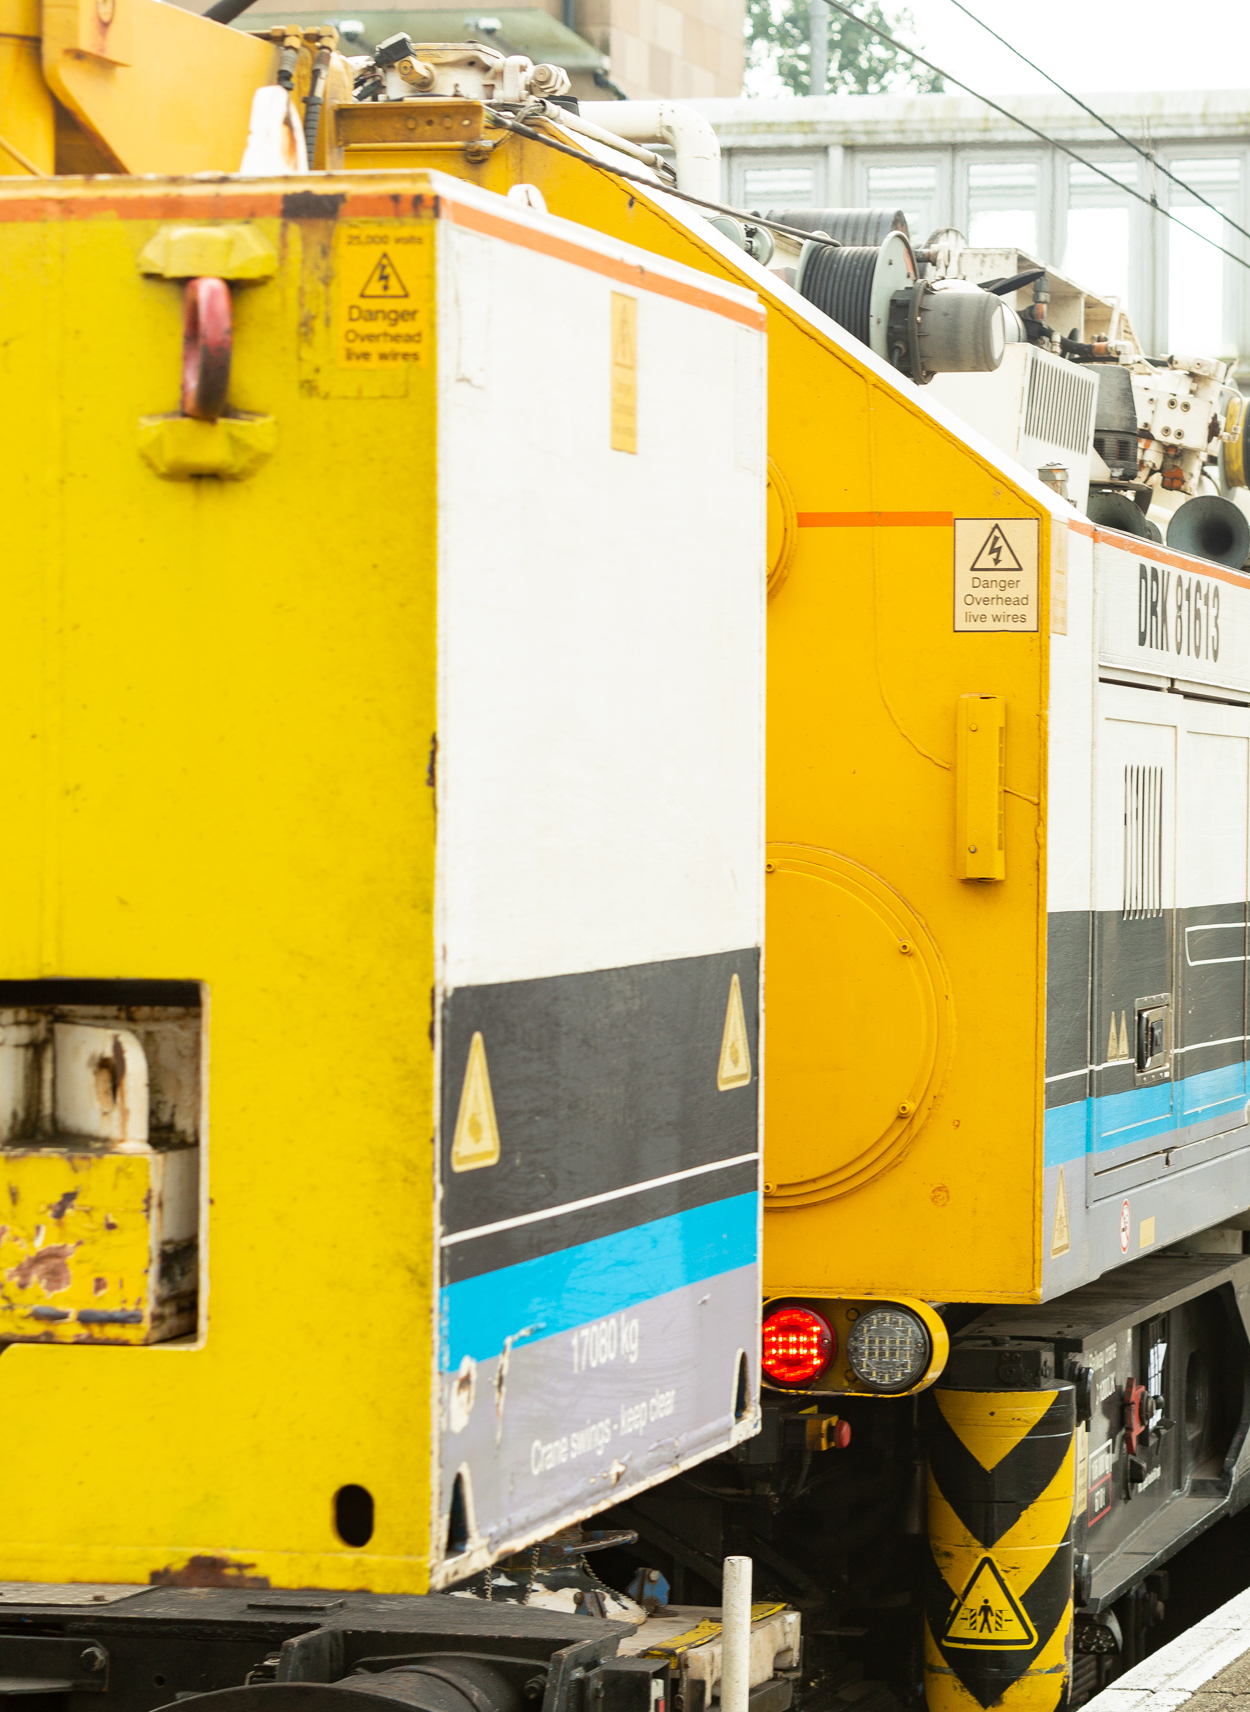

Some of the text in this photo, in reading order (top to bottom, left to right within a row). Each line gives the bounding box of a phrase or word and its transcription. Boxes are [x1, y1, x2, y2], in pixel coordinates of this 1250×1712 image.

[394, 235, 424, 245] volts
[348, 305, 419, 327] Danger
[345, 329, 422, 344] Overhead
[345, 347, 420, 362] live wires
[971, 576, 1021, 592] Danger
[963, 593, 1029, 606] Overhead
[964, 611, 1027, 623] live wires
[1138, 563, 1170, 652] DRK
[1174, 574, 1220, 663] 81613
[571, 1313, 639, 1374] 17080 kg
[530, 1436, 569, 1476] Crane
[569, 1417, 612, 1456] swings
[619, 1401, 648, 1436] keep
[649, 1387, 676, 1422] clear
